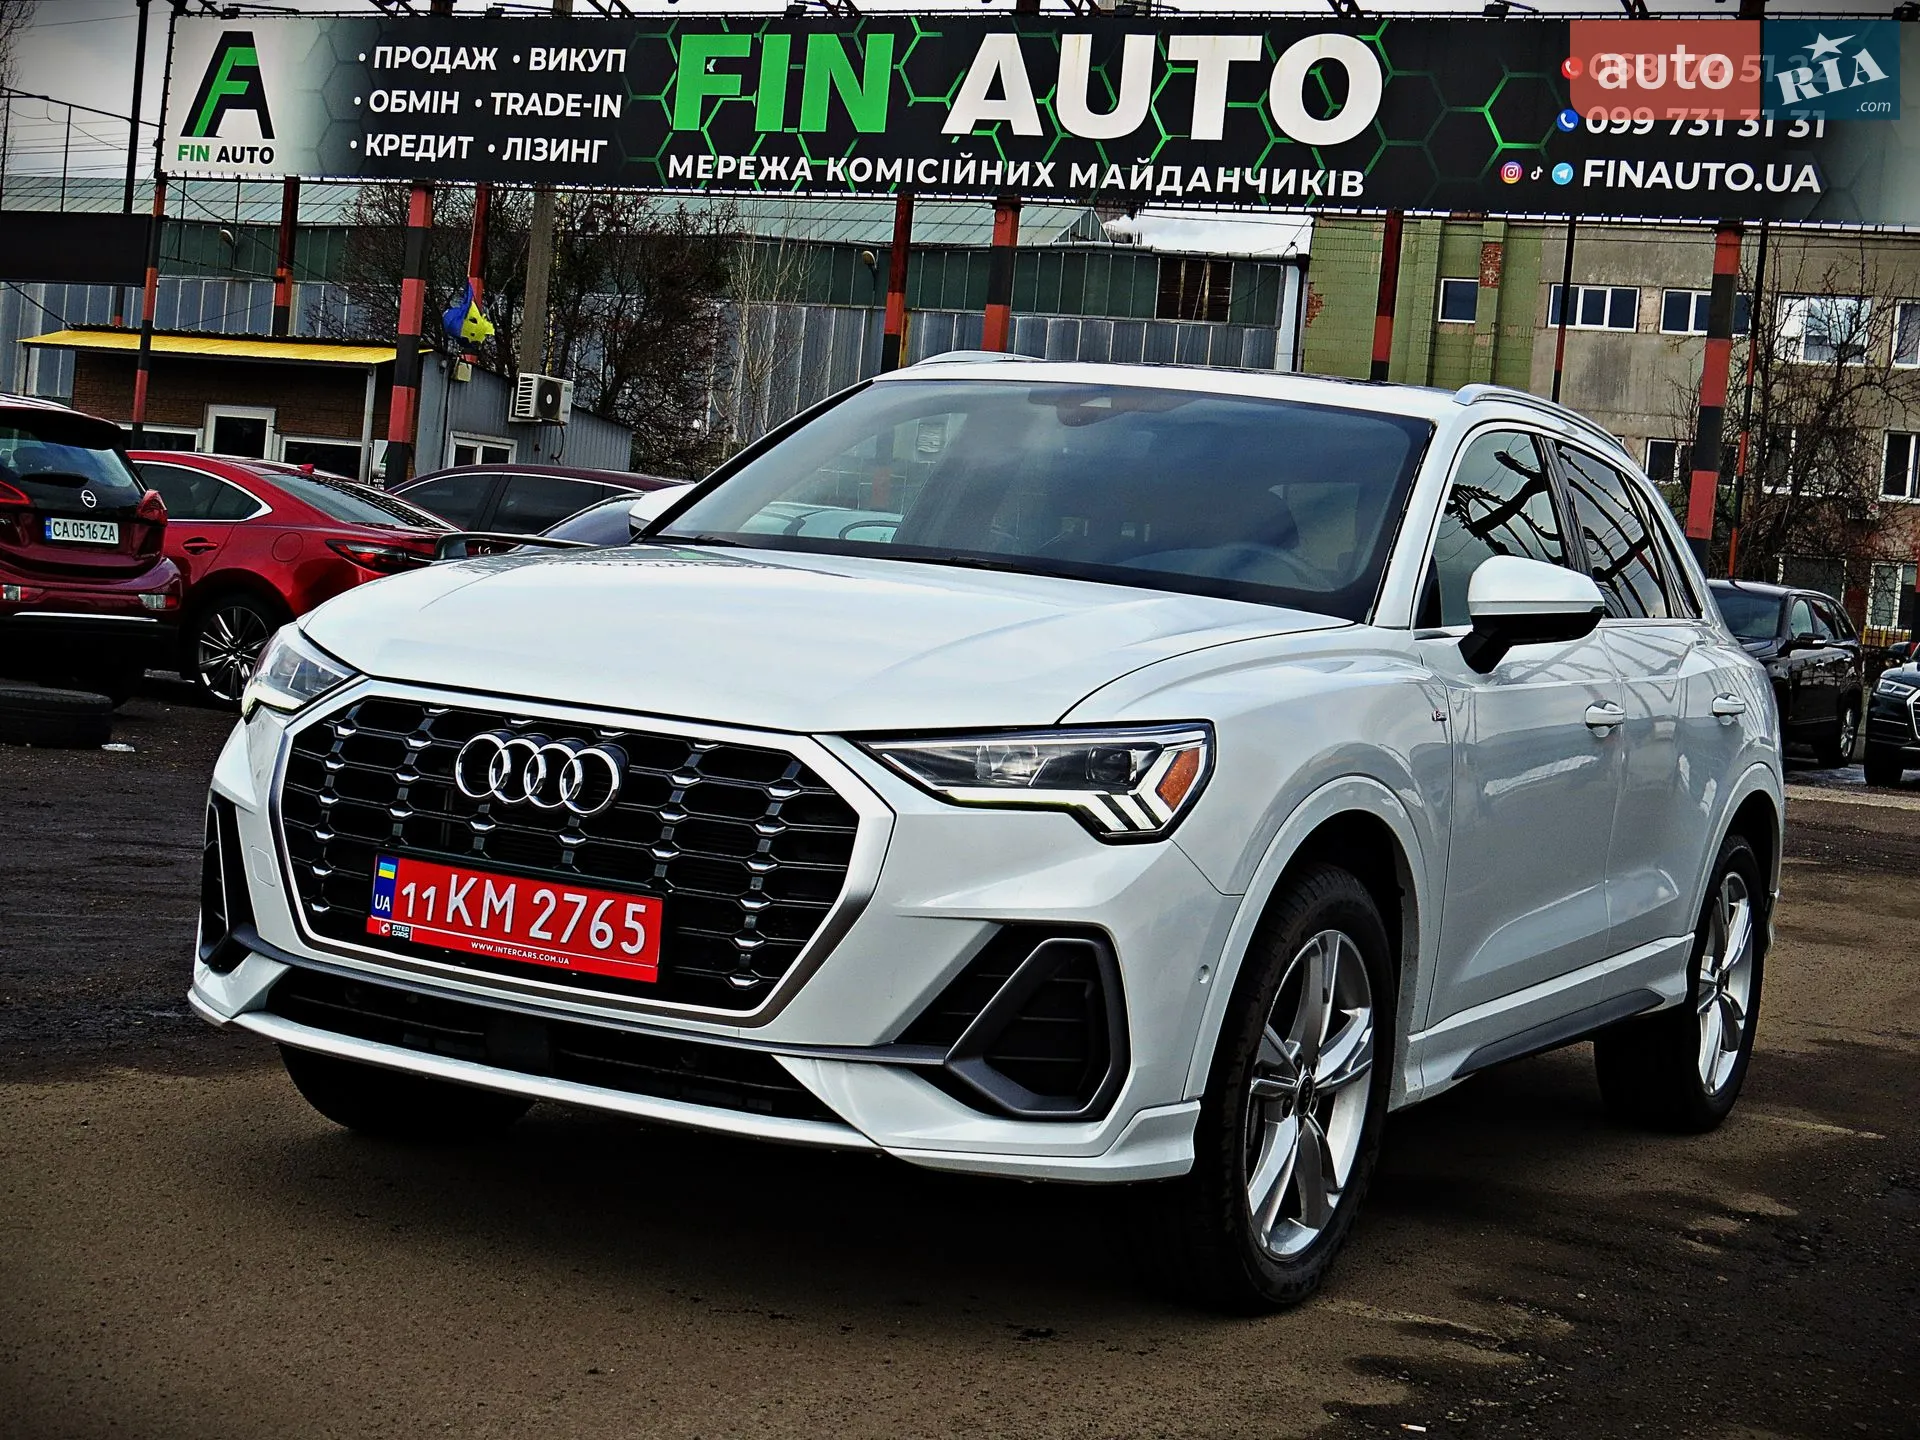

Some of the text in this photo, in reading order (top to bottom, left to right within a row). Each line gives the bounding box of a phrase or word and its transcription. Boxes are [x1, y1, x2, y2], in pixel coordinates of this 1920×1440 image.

[373, 46, 627, 74] ПРОДАЖ ВИКУП
[368, 89, 622, 118] ОБМІН TRADE-IN
[672, 32, 1384, 146] FIN AUTO
[1585, 106, 1826, 139] 099 731 31 31
[177, 144, 275, 165] FIN AUTO
[364, 133, 608, 164] КРЕДИТ ЛІЗИНГ
[667, 150, 1365, 198] МЕРЕЖА КОМІСІЙНИХ МАЙДАНЧИКІВ
[1583, 159, 1822, 194] FINAUTO.UA
[52, 521, 116, 541] CA 0516 ZA
[374, 893, 391, 912] UA
[528, 888, 647, 955] 2765
[471, 941, 570, 965] WWW.INTERCARS.COM.UA
